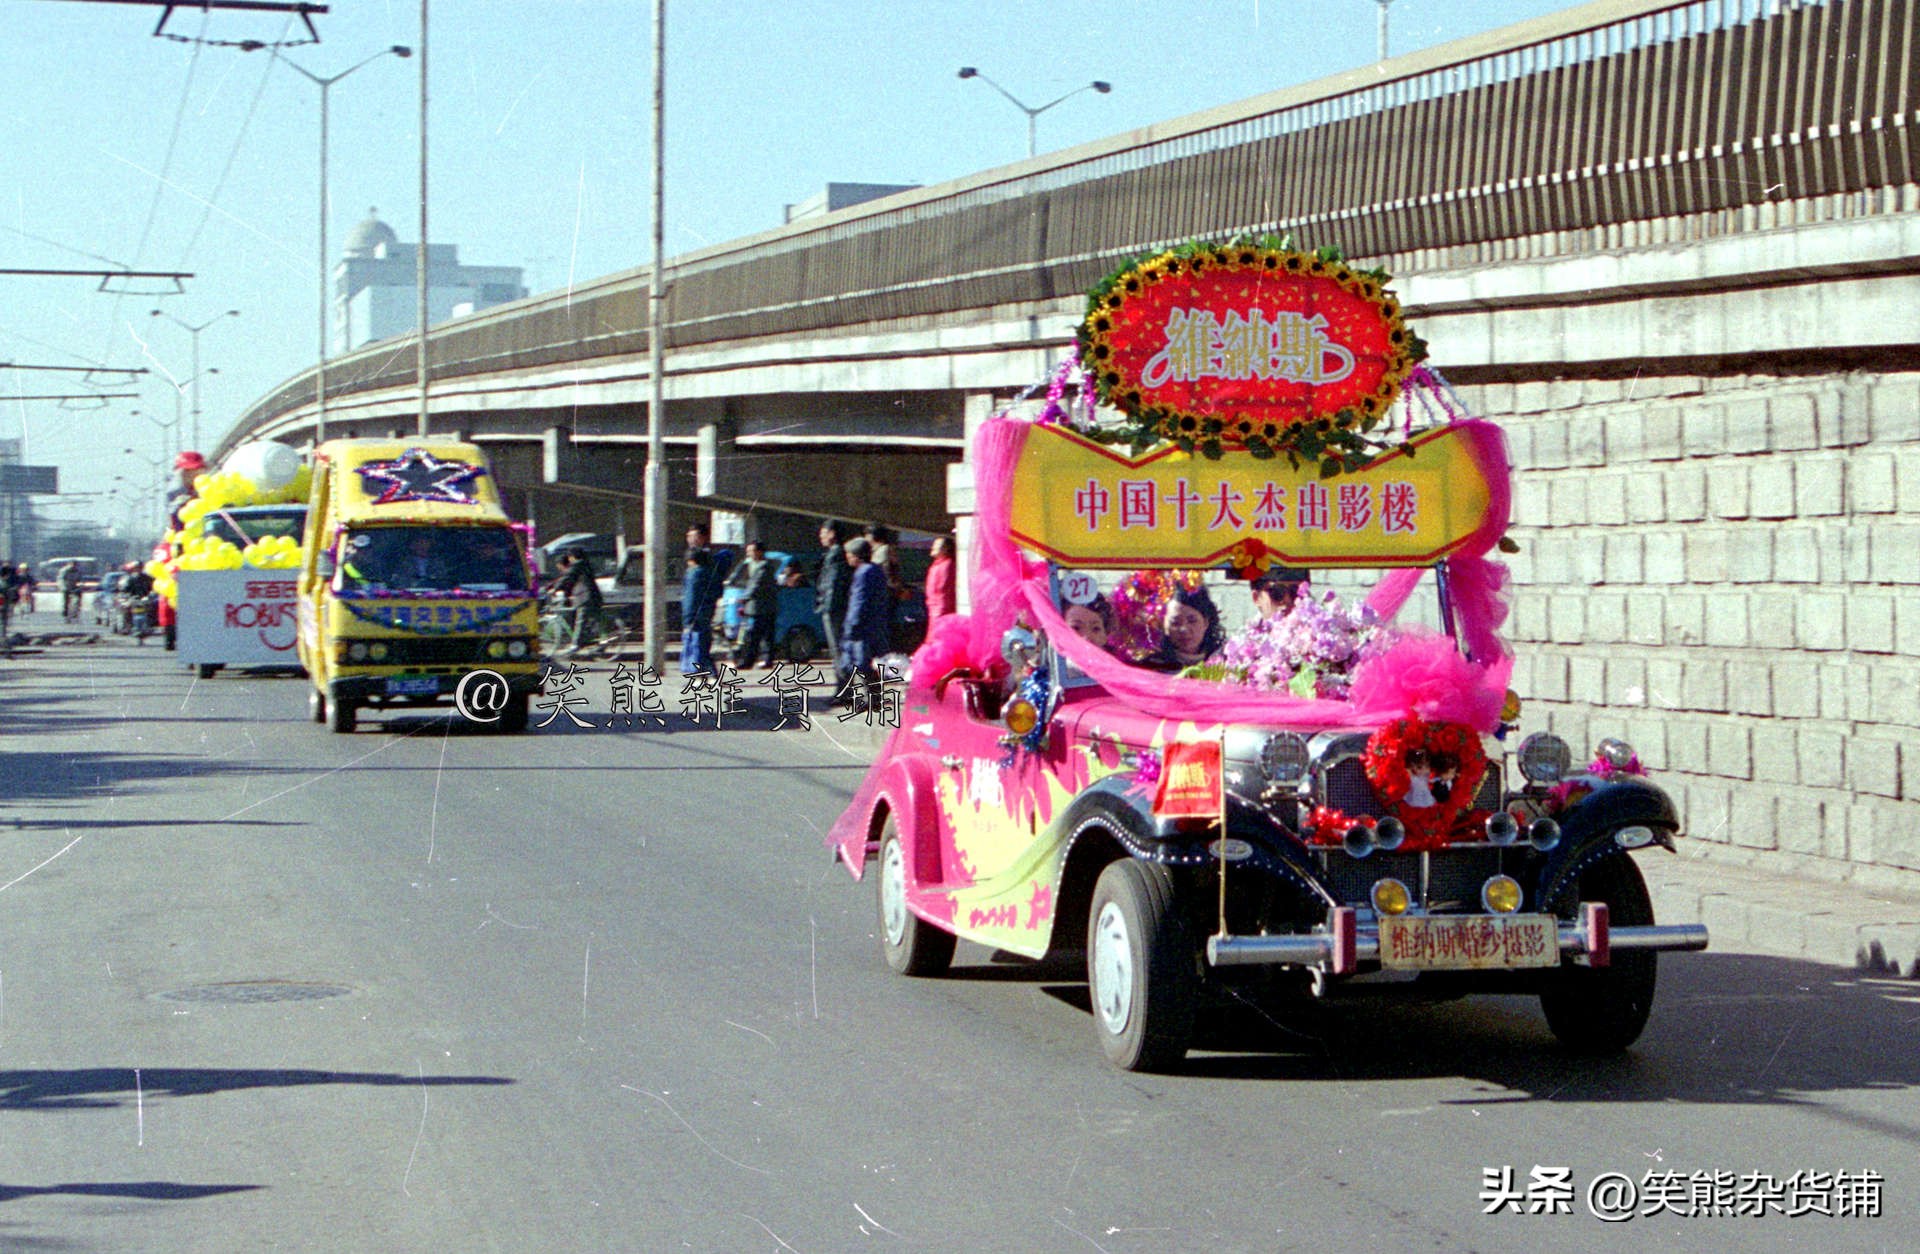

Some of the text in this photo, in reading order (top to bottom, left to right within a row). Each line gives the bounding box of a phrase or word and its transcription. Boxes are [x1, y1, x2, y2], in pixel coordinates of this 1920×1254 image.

[1075, 477, 1418, 534] 中国十大杰出影楼
[1069, 577, 1088, 598] 27
